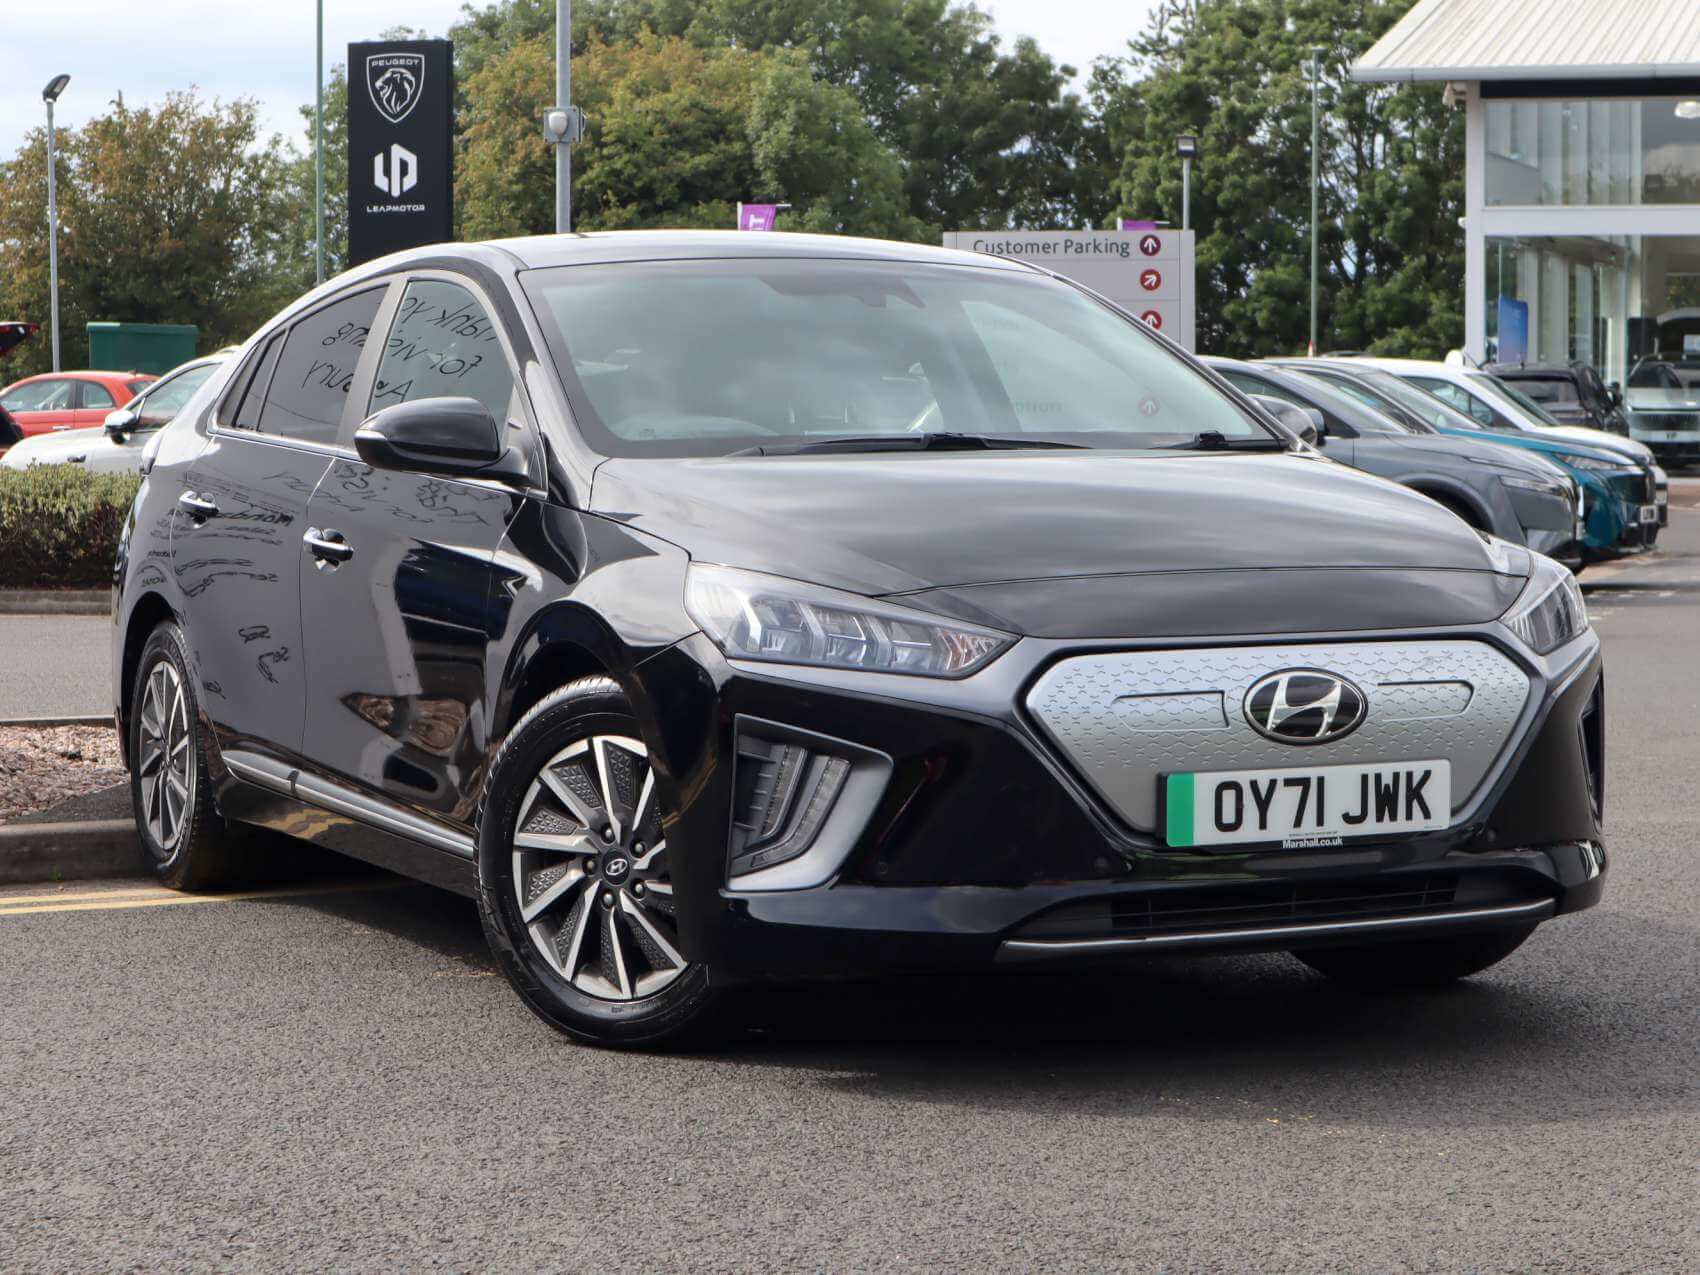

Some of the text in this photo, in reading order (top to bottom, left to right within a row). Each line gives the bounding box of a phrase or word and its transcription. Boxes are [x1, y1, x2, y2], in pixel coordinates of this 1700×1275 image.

[371, 58, 420, 67] PEUGEOT
[366, 204, 426, 213] LEAPMOTOR
[973, 238, 1130, 258] Customer Parking
[1214, 769, 1432, 832] OY71 JWK
[1282, 836, 1343, 849] Marshall.co.uk
